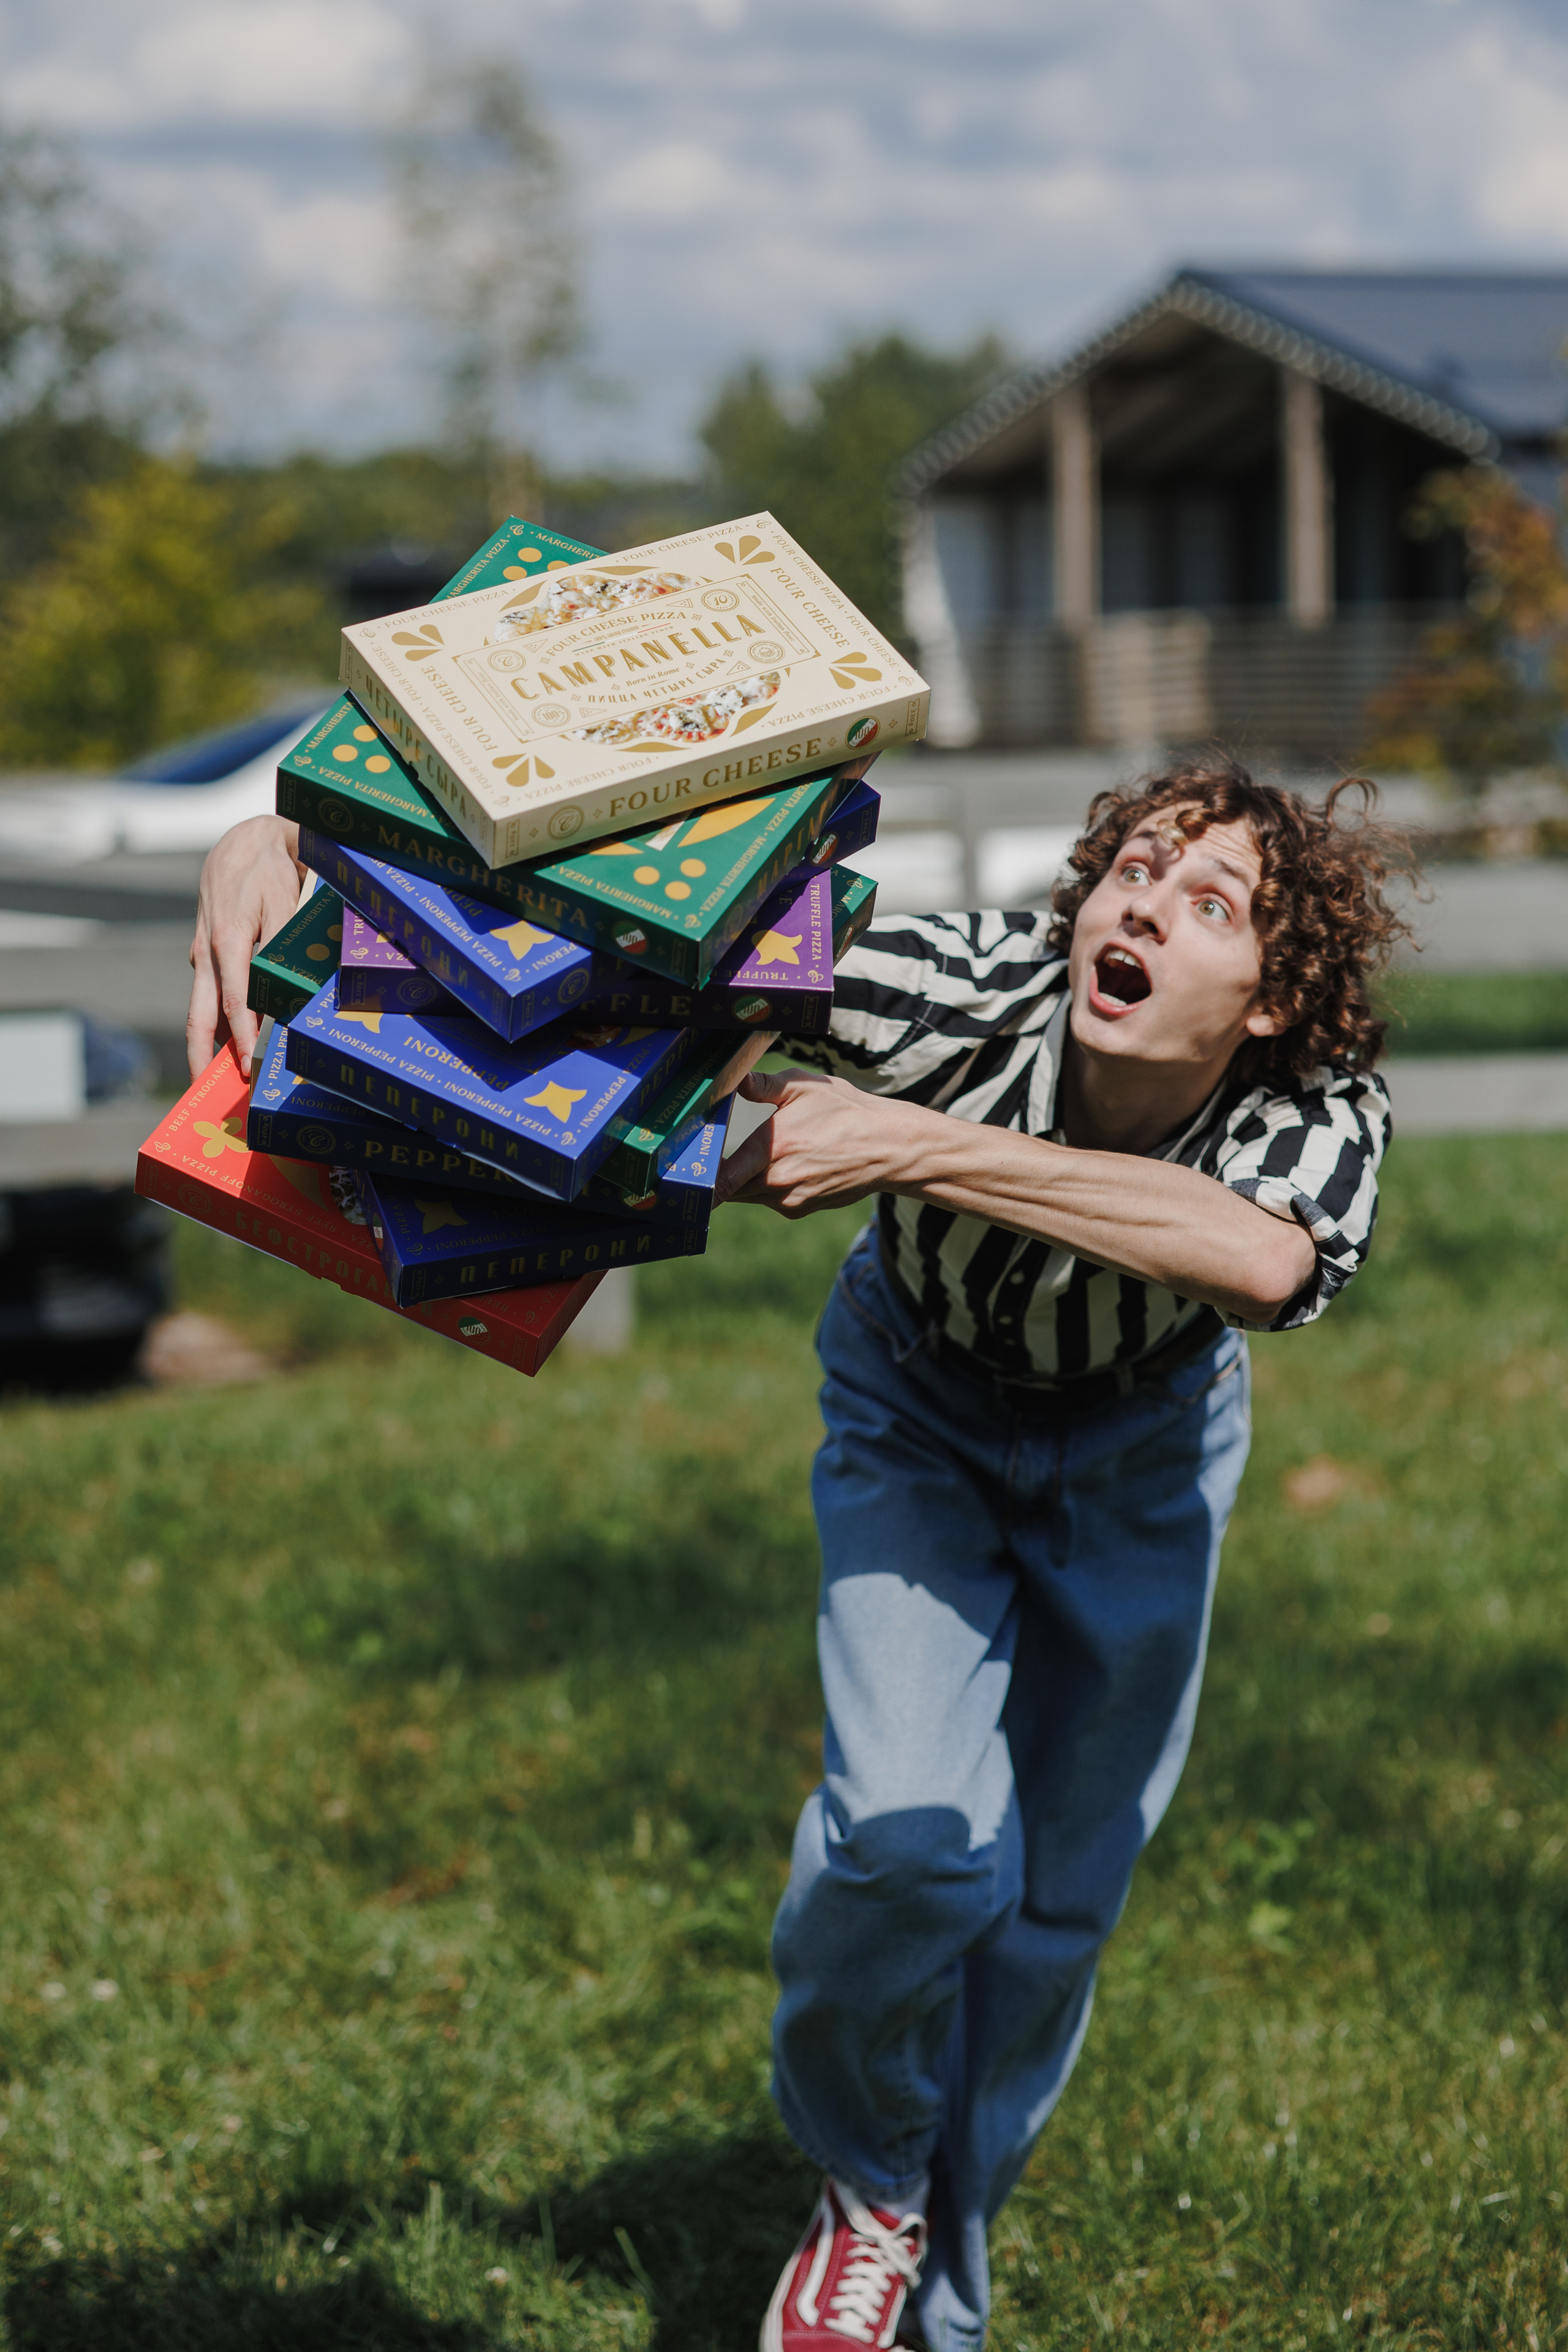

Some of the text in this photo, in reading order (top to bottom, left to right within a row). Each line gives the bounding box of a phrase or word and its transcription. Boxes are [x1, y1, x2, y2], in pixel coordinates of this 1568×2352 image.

[485, 538, 510, 560] PIZZA
[535, 532, 602, 559] MARGHERIT
[622, 525, 744, 563] FOUR CHEESE PIZZA
[773, 533, 845, 610] FOUR CHEESE PIZZA
[385, 589, 510, 628] FOUR CHEESE PIZZA
[752, 595, 796, 642] Made with Italian flour
[770, 567, 851, 648] FOUR CHEESE
[511, 614, 766, 701] CAMPANELLA
[545, 611, 687, 657] FOUR CHEESE PIZZA
[619, 633, 648, 644] ITALIAN
[651, 625, 674, 635] FLOUR
[846, 614, 899, 669] FOUR CHEESE
[371, 646, 422, 702] FOUR CHEESE
[588, 658, 726, 704] ПИЦЦА ЧЕТЫРЕ СЫРА
[625, 677, 647, 687] Born
[657, 666, 680, 678] Rome
[307, 701, 354, 749] MARGHERITA
[421, 665, 498, 752] FOUR CHEESE
[767, 686, 891, 727] FOUR CHEESE PIZZA
[908, 707, 918, 727] 330g
[365, 673, 468, 820] ЧЕТЫРЕ СЫРА
[422, 706, 494, 791] FOUR CHEESE PIZZA
[318, 766, 430, 818] MARGHERITA PIZZA
[524, 757, 652, 801] FOUR CHEESE PIZZA
[609, 737, 821, 818] FOUR CHEESE
[765, 805, 790, 832] PIZZA
[377, 824, 589, 930] MARGHERITA
[385, 866, 417, 893] PIZZA
[719, 834, 768, 889] MARGHERITA
[559, 865, 674, 920] MARGHERITA PIZZA
[699, 888, 726, 912] PIZZA
[281, 897, 331, 946] MARGHERITA
[337, 860, 469, 990] ПЕПЕРОНИ
[418, 895, 472, 944] PEPPERONI
[472, 940, 503, 968] PIZZA
[810, 883, 822, 961] TRUFFLE PIZZA
[531, 941, 578, 971] PERONI
[268, 1050, 285, 1080] PIZZA
[328, 1028, 435, 1083] PIZZA PEPPERONI
[402, 1035, 510, 1092] PEPPERONI
[168, 1053, 233, 1133] BEEF STROGANOF
[291, 1096, 366, 1117] PEPPERONI
[340, 1063, 519, 1161] ПЕПЕРОНИ
[443, 1080, 552, 1136] PIZZA PEPPERONI
[579, 1074, 627, 1129] PEPPERONI
[655, 1099, 681, 1125] PIZZA
[365, 1139, 515, 1184] PEPPER
[183, 1154, 338, 1232] BEEF STROGANOFF PIZZA
[392, 1204, 411, 1234] PIZZA
[435, 1233, 507, 1251] PEPPERONI
[460, 1234, 652, 1284] ПЕПЕРОНИ
